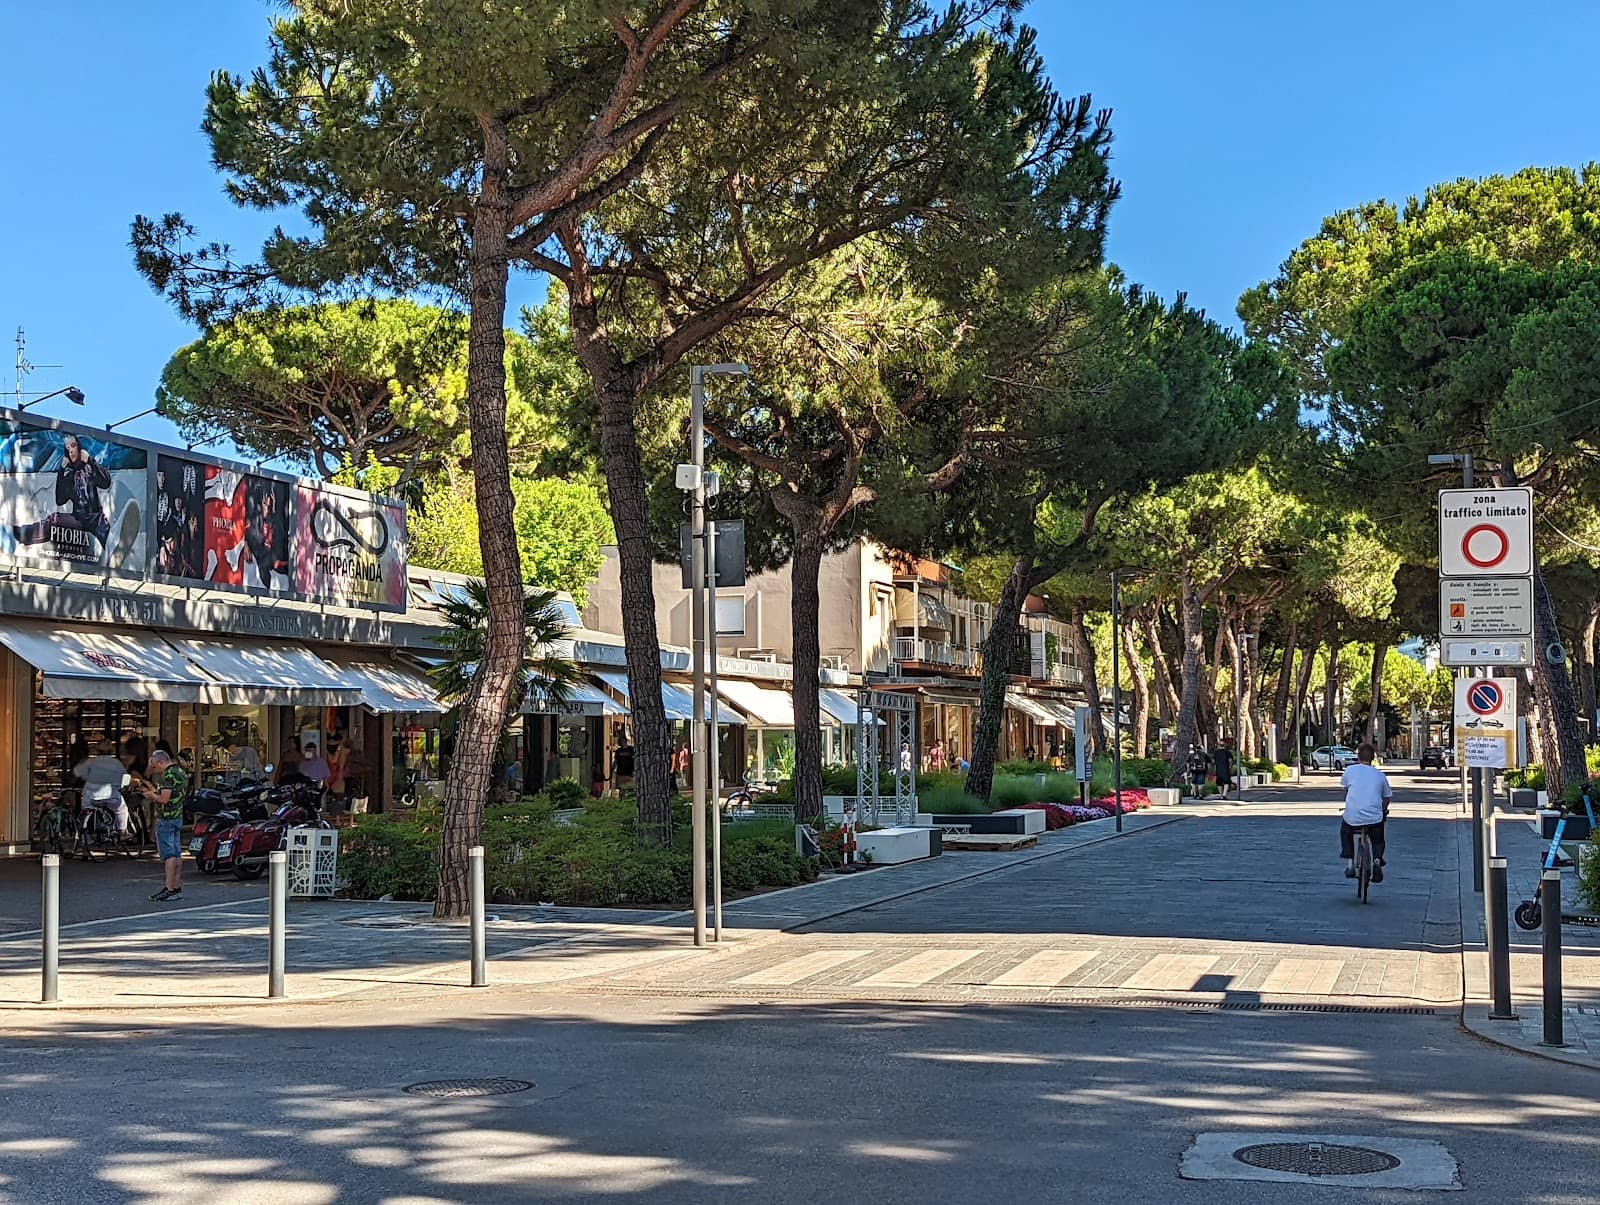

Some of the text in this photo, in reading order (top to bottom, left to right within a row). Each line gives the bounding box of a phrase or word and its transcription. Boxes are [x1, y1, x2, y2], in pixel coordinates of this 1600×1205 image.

[1473, 495, 1496, 504] zona
[1444, 506, 1527, 518] traffico limitato
[50, 525, 90, 546] PHOBIA
[315, 553, 383, 583] PROPAGANDA
[99, 597, 157, 620] AREA 51
